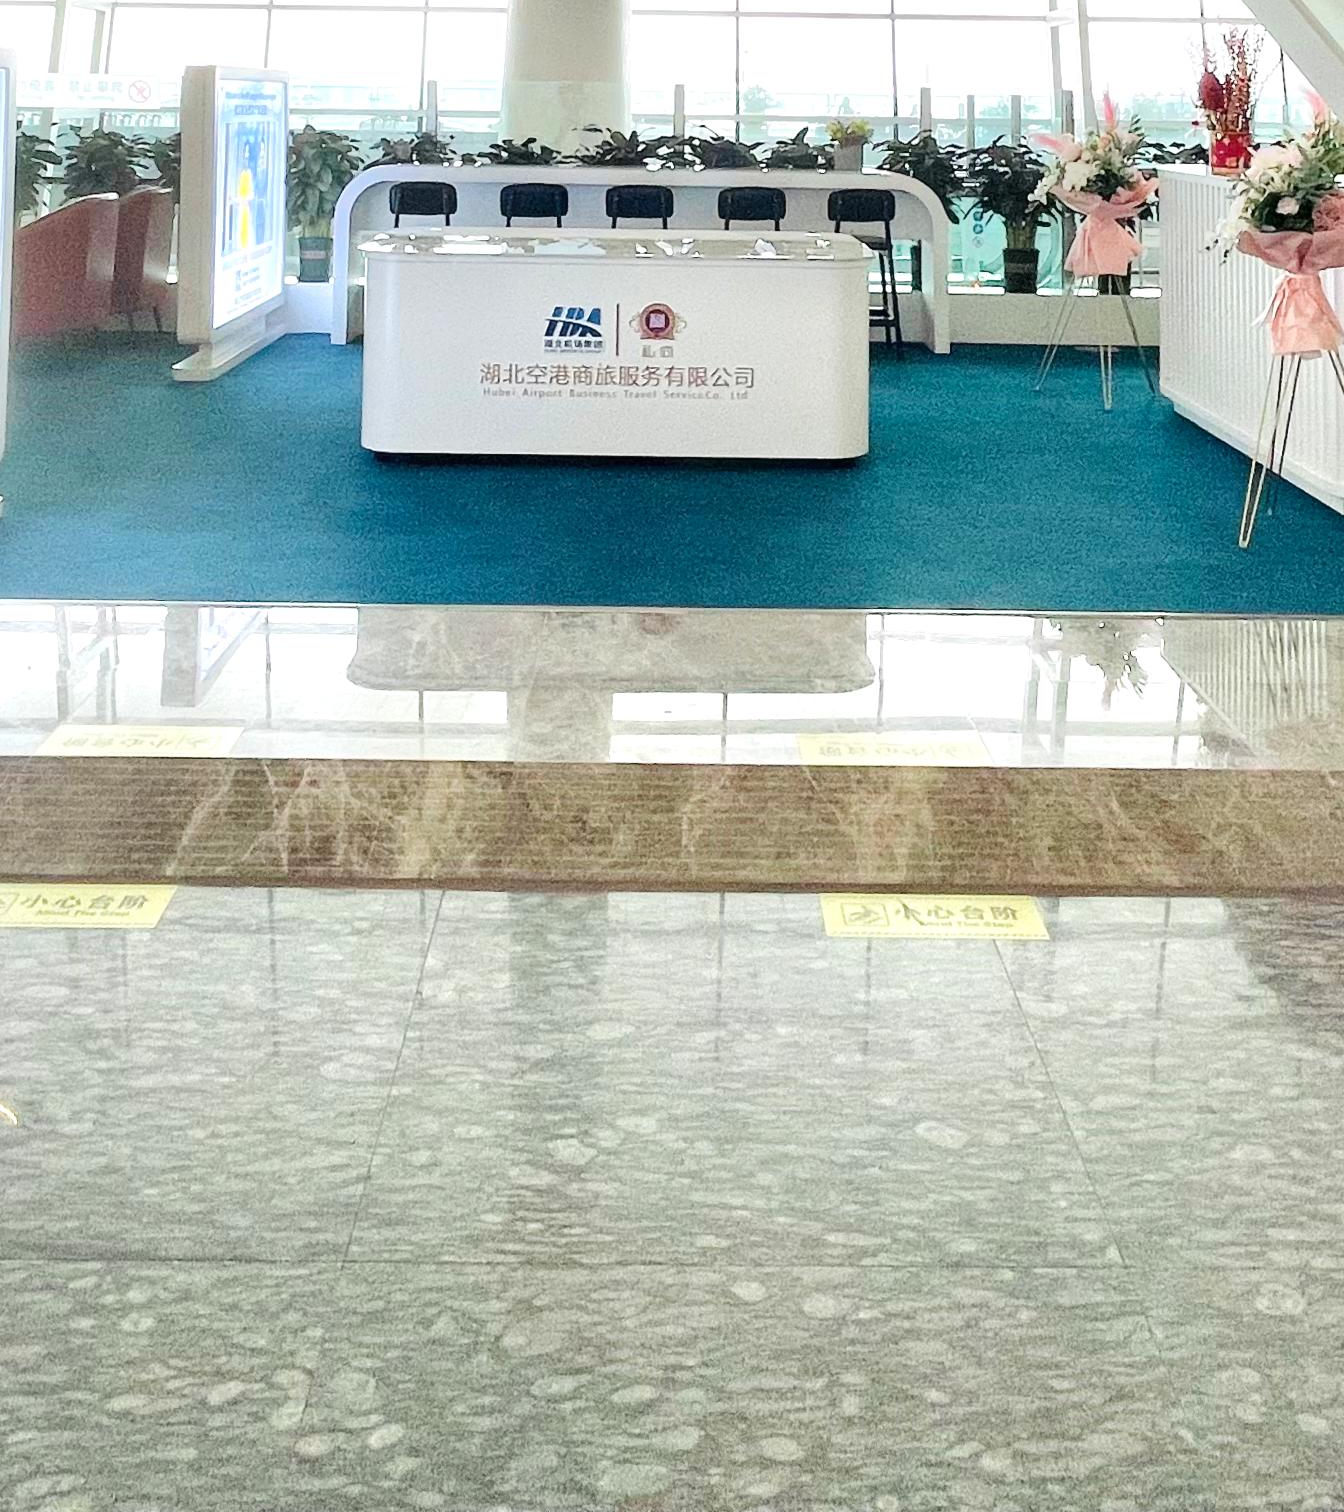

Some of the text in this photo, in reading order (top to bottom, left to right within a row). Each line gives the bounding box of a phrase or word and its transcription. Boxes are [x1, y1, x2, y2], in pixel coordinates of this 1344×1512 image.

[480, 363, 754, 388] 湖北空港商旅服务有限公司
[483, 388, 516, 397] Hubei
[522, 388, 562, 399] Airport
[20, 894, 149, 909] 小心台阶
